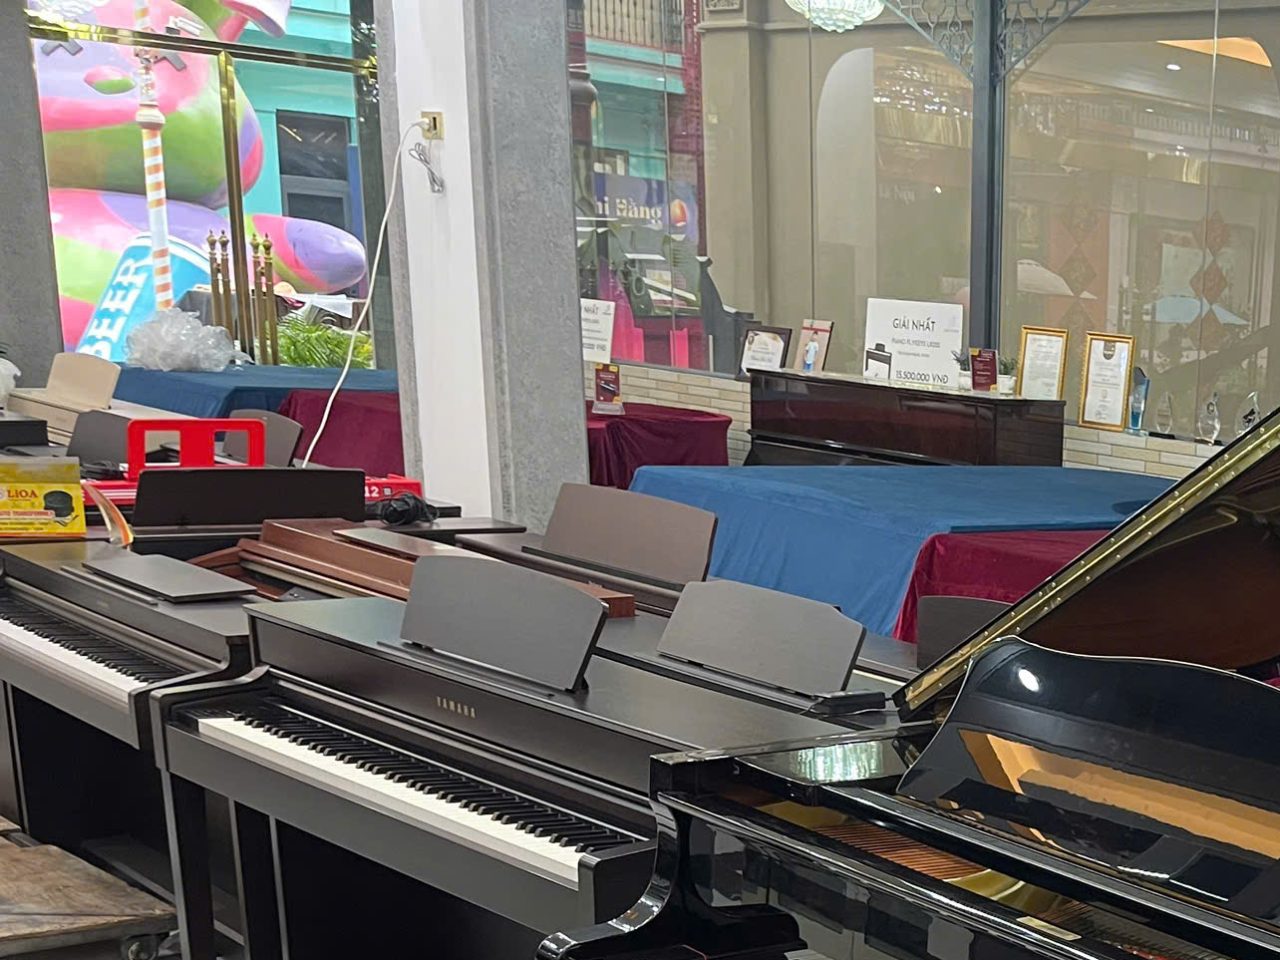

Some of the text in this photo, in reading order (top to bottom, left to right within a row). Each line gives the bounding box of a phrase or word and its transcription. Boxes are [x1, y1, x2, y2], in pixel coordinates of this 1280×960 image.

[912, 316, 936, 332] NHẤT
[896, 370, 930, 383] 15.500.000
[436, 695, 476, 719] YAMAHA
